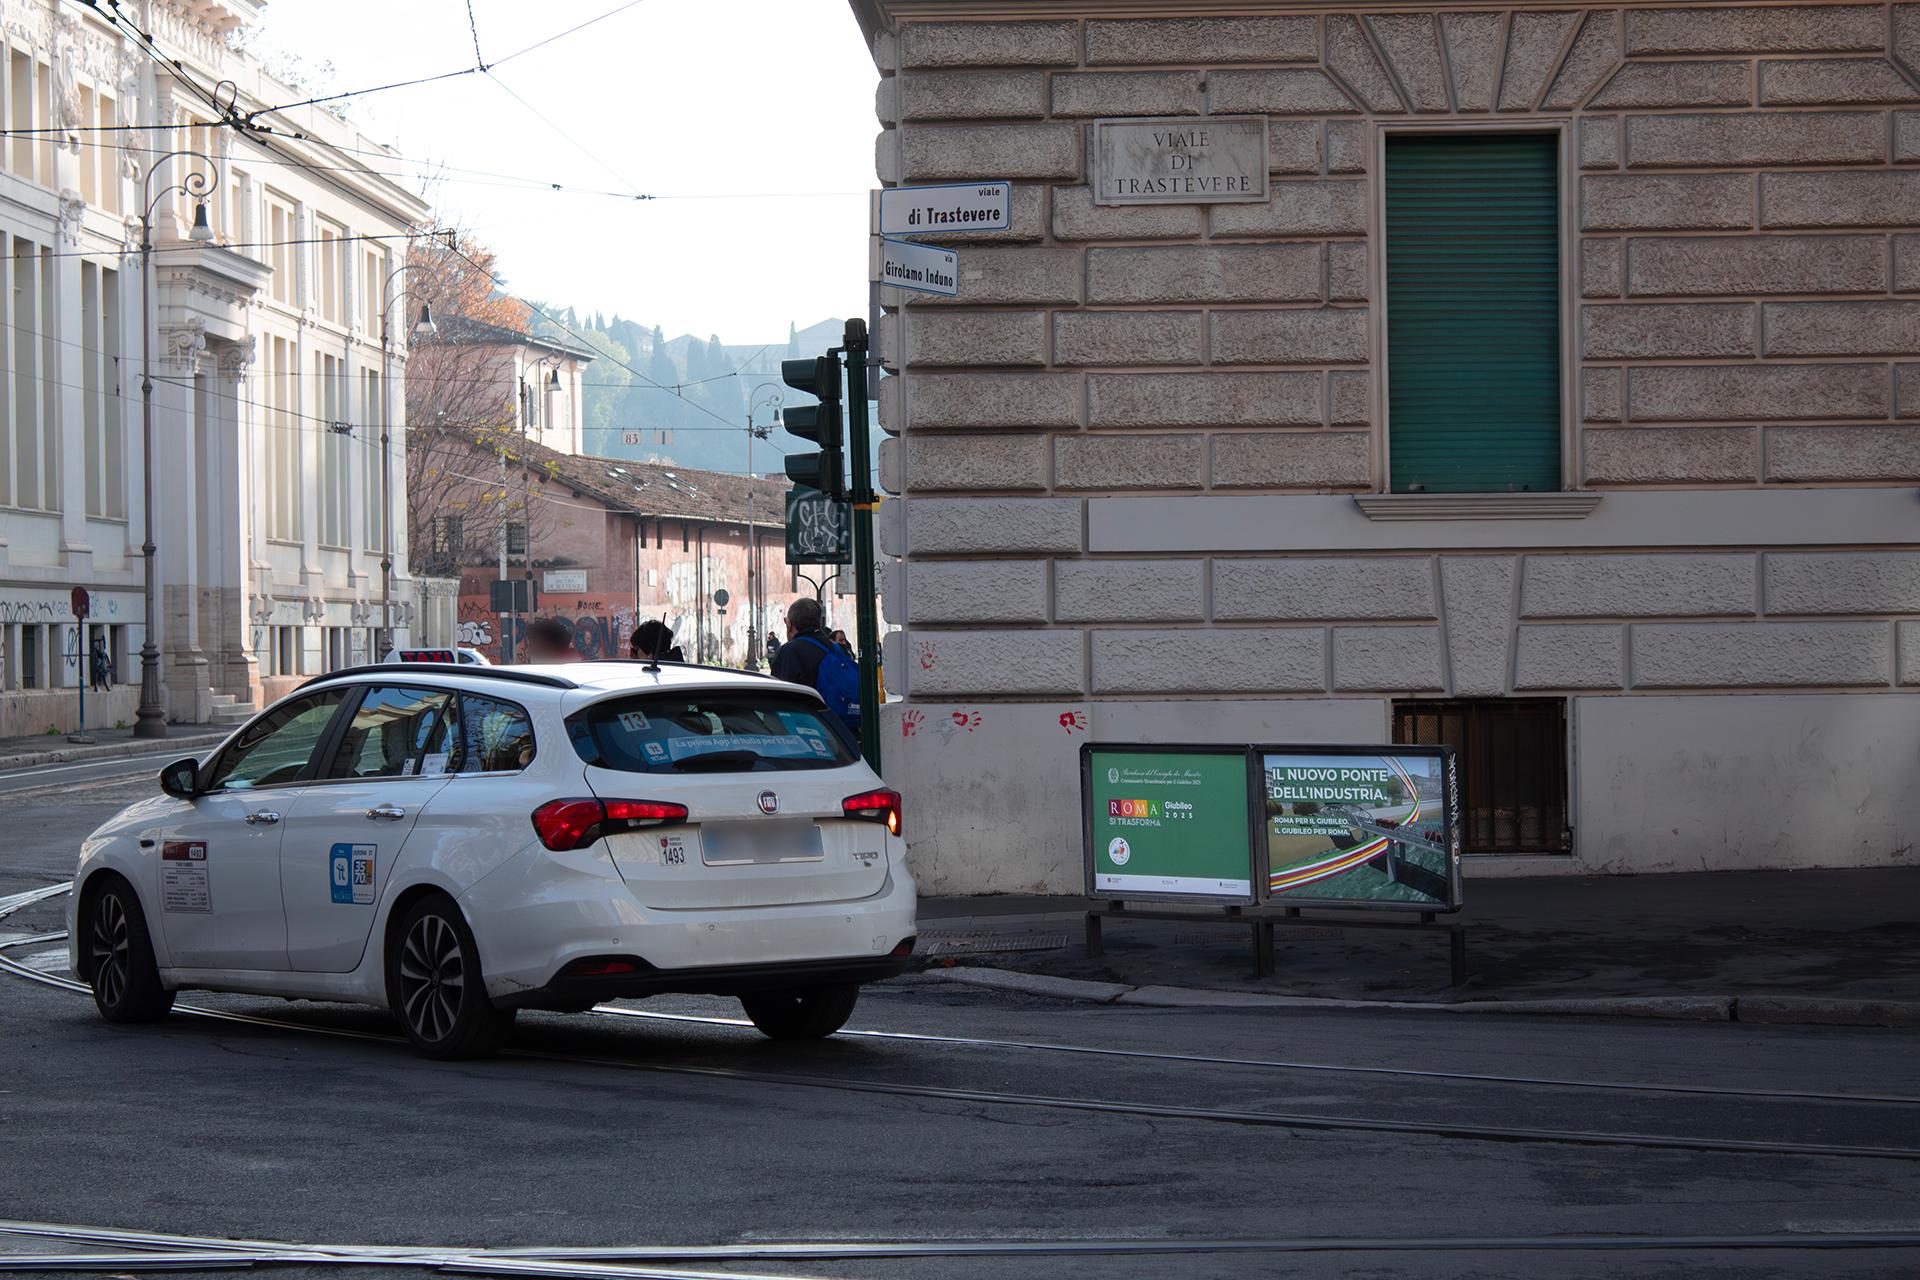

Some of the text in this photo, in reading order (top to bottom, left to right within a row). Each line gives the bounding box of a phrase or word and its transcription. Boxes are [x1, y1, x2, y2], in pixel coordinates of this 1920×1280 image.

[1153, 132, 1210, 147] VIALE
[1171, 155, 1193, 170] DI
[1114, 176, 1251, 194] TRASTEVERE
[978, 187, 1000, 197] viale
[908, 206, 1000, 225] di Trastevere
[944, 254, 953, 263] via
[885, 260, 953, 288] Girolamo Induno
[625, 433, 639, 445] 83
[401, 652, 451, 663] TAXI
[623, 715, 646, 730] 13
[713, 738, 730, 747] App
[1272, 768, 1388, 782] IL NUOVO PONTE
[1273, 786, 1388, 800] DELL'INDUSTRIA.
[762, 796, 776, 809] FIAT
[1110, 801, 1158, 816] ROMA
[1164, 801, 1193, 810] Giubileo
[1109, 817, 1161, 827] SI TRASFORMA
[663, 847, 685, 864] 1493
[354, 860, 367, 873] 35
[354, 872, 367, 884] 70
